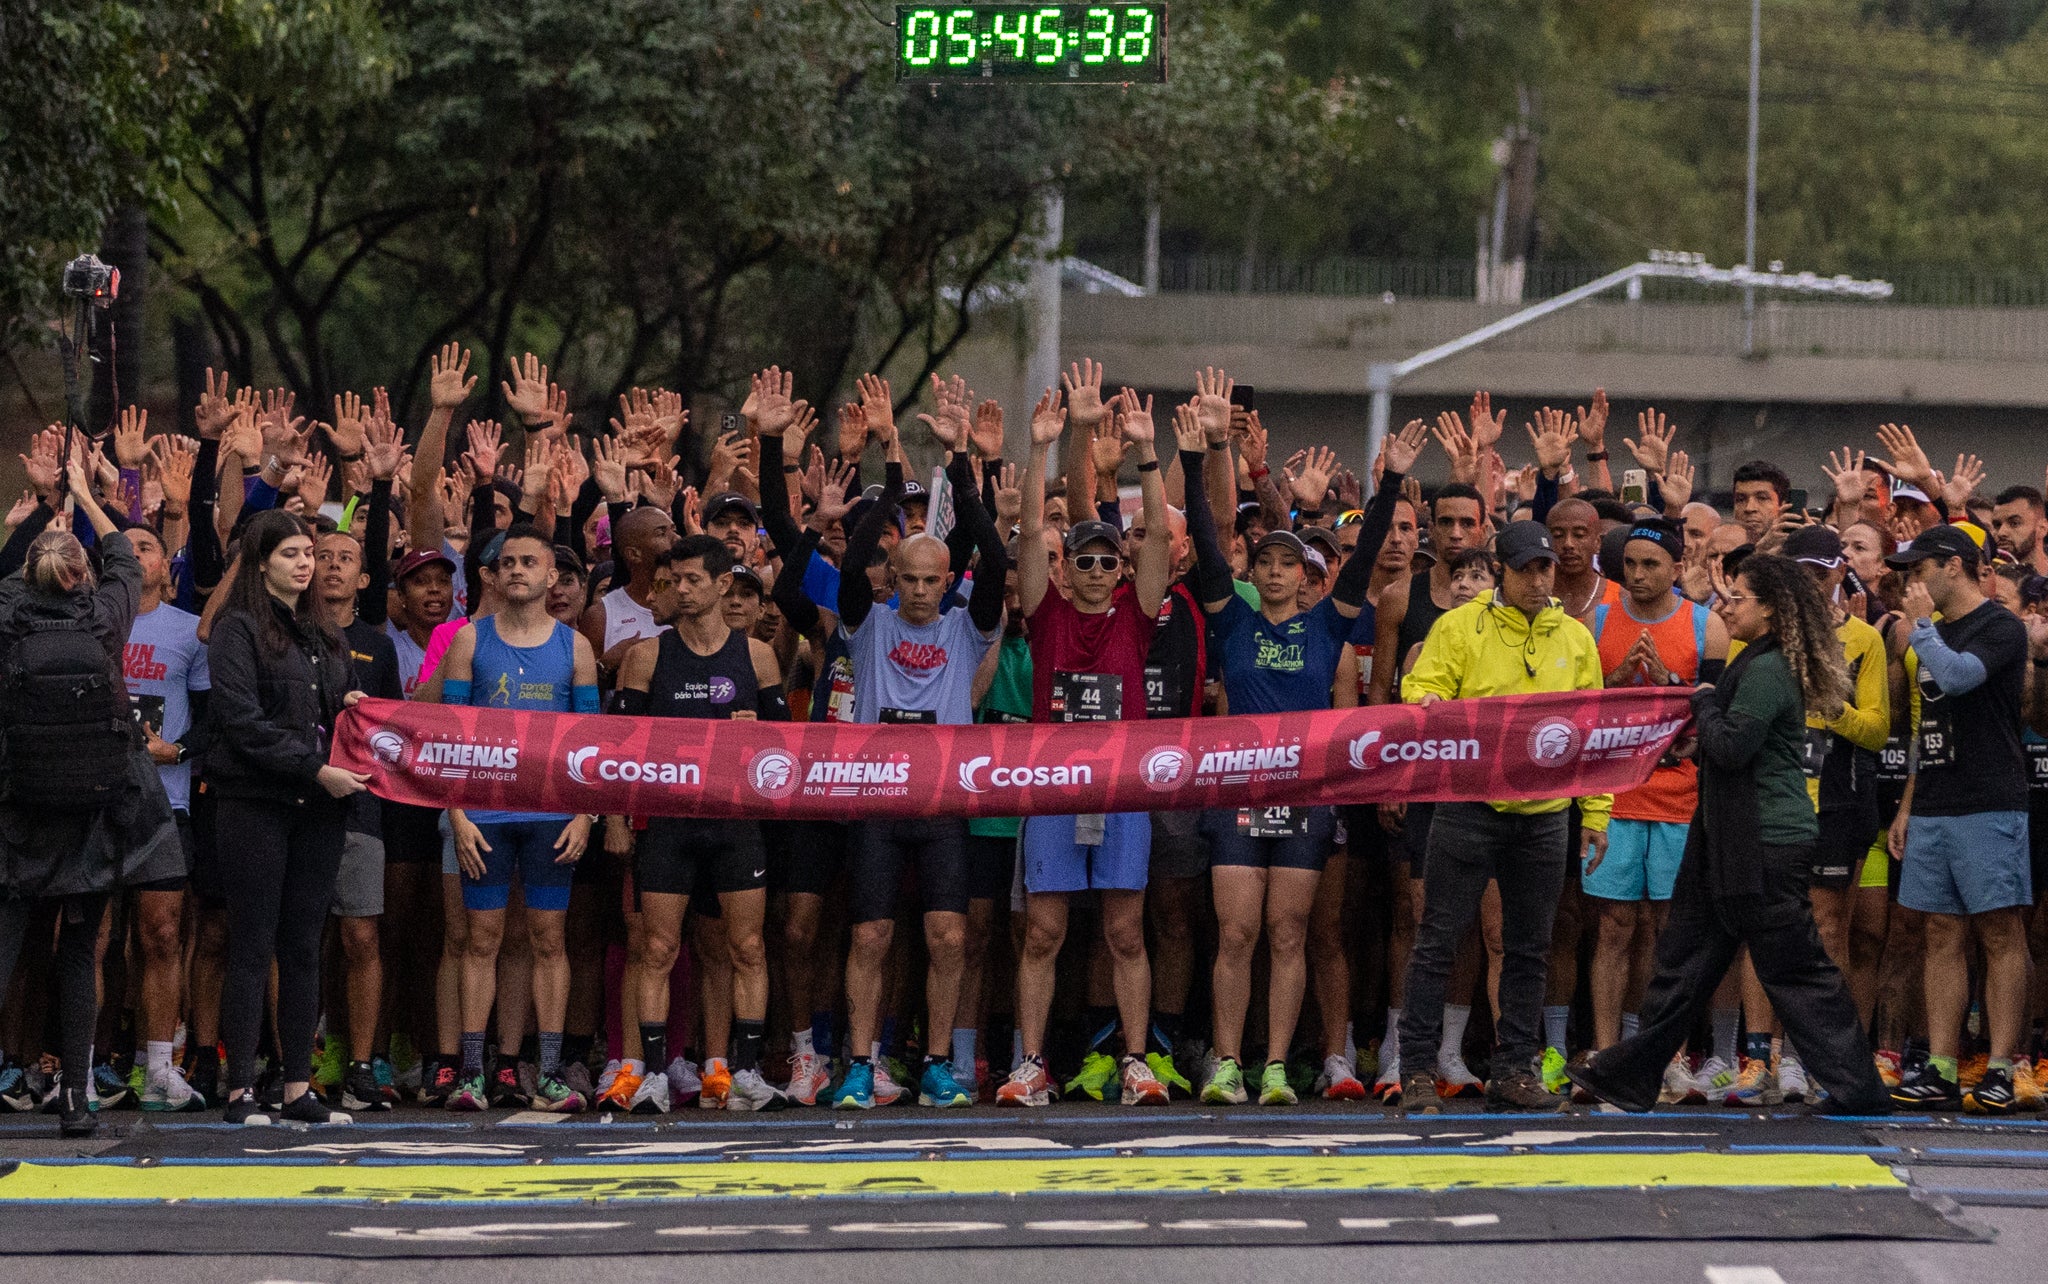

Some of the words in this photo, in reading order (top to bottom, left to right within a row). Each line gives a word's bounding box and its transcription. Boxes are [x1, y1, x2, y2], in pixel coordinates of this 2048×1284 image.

[1630, 527, 1662, 541] JESUS
[122, 643, 155, 661] UN
[123, 658, 167, 680] NGER
[1081, 688, 1101, 704] 44
[1146, 680, 1164, 696] 91
[1585, 712, 1673, 727] CIRCUIT
[416, 731, 518, 745] CIRCUITO
[1198, 736, 1301, 751] CIRCUITO
[1924, 733, 1943, 749] 153
[416, 741, 520, 770] ATHENAS
[807, 752, 911, 761] CIRCUITO
[1379, 738, 1480, 764] cosan
[1580, 752, 1602, 762] RUN
[1879, 749, 1906, 765] 105
[1197, 745, 1302, 774] ATHENAS
[414, 765, 437, 777] RUN
[472, 770, 518, 782] LONGER
[599, 758, 700, 785] cosan
[806, 761, 911, 784] ATHENAS
[990, 764, 1092, 787] cosan
[1194, 776, 1217, 787] RUN
[1253, 770, 1299, 783] LONGER
[803, 786, 826, 796] RUN
[862, 786, 909, 797] LONGER
[1263, 805, 1291, 819] 214
